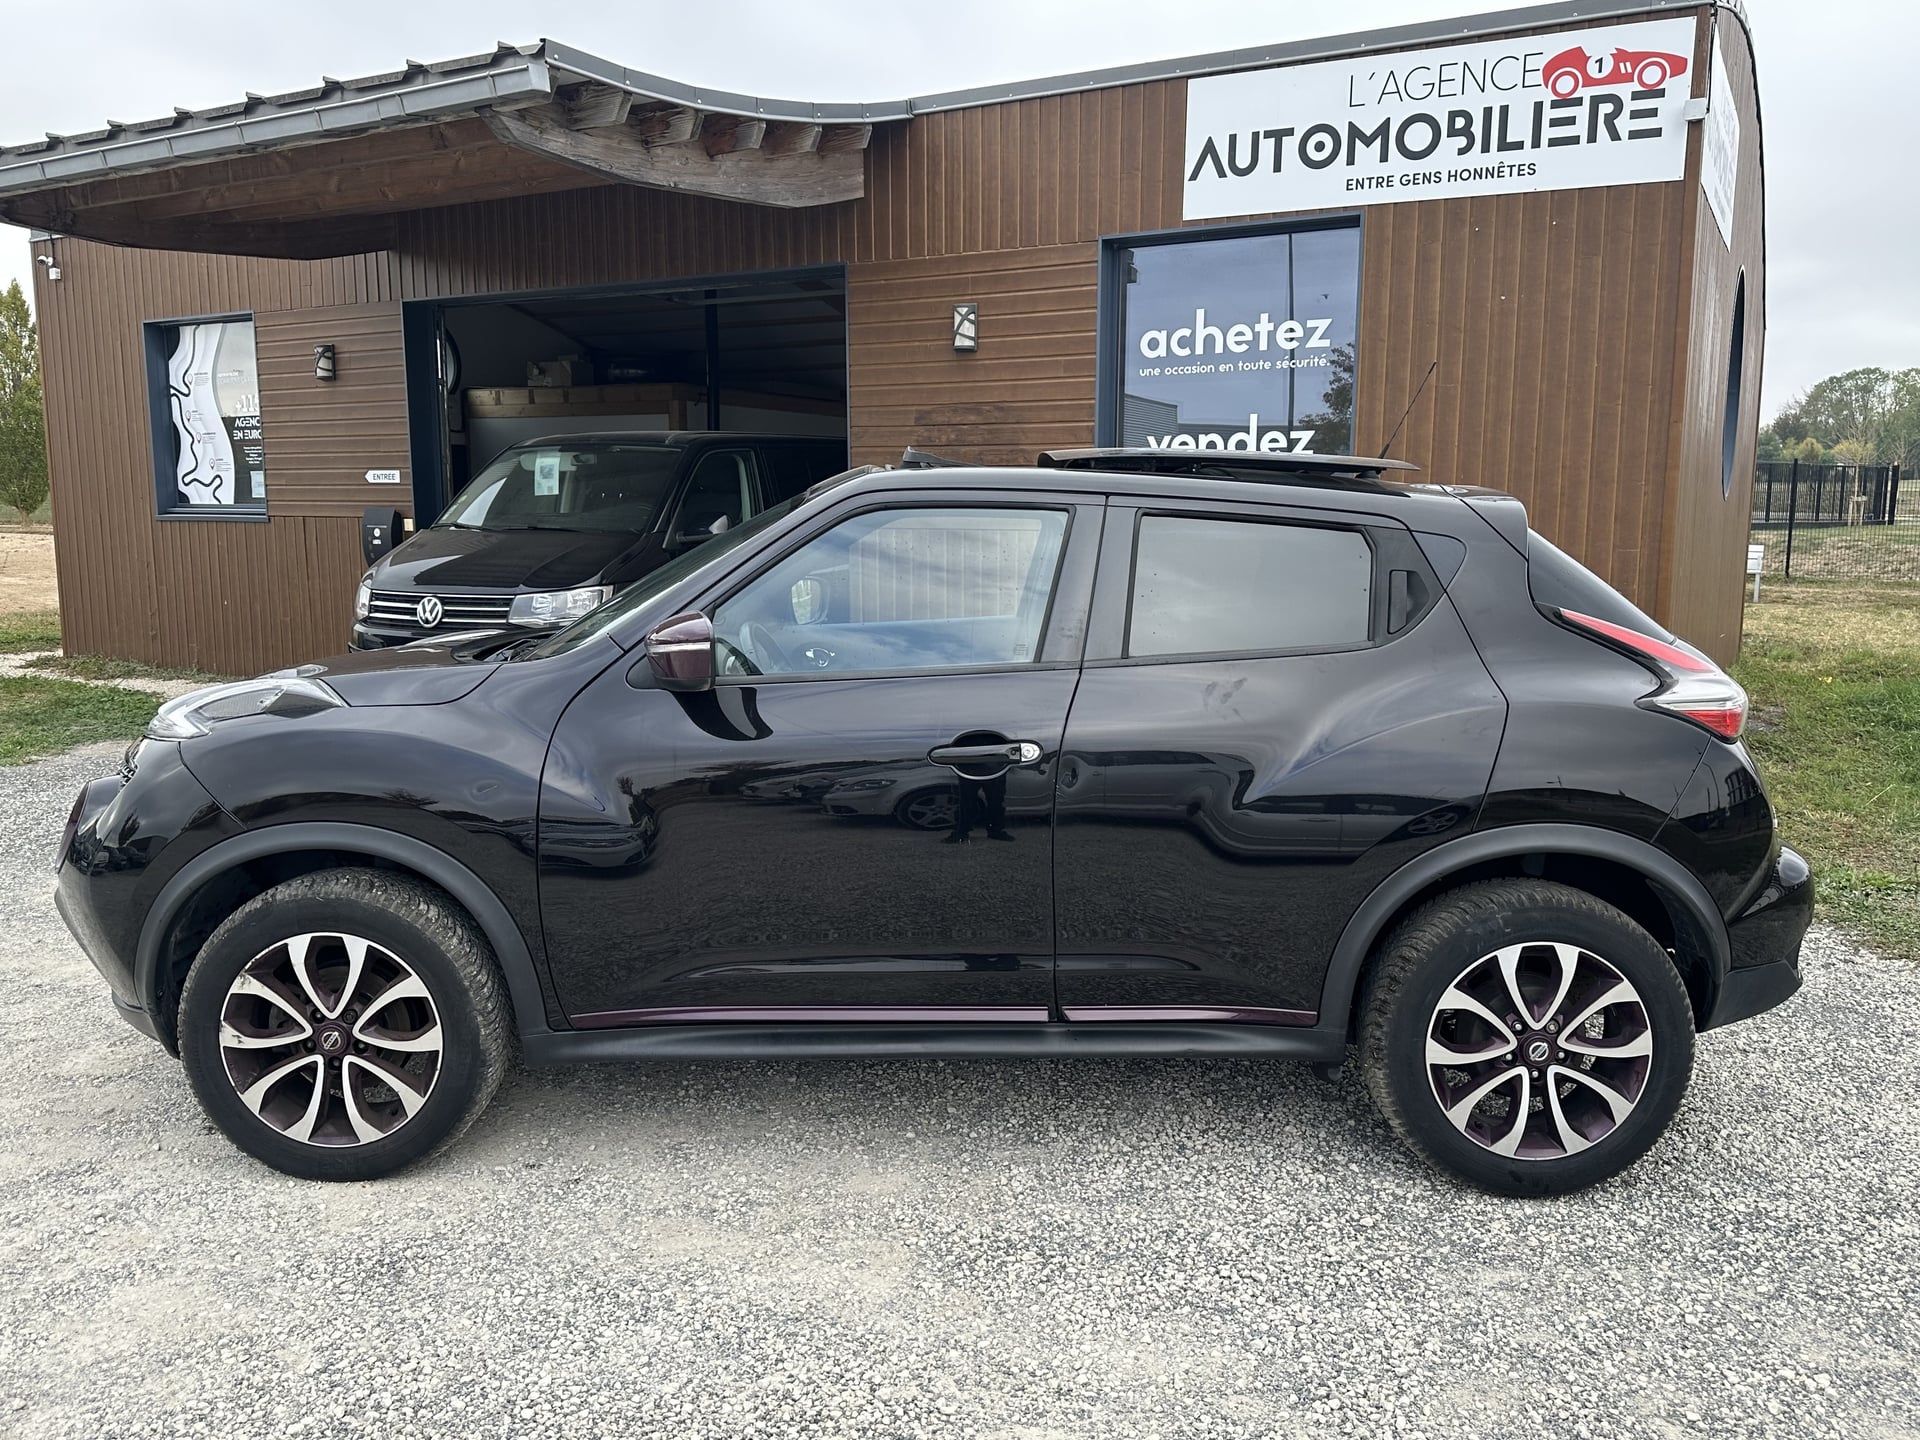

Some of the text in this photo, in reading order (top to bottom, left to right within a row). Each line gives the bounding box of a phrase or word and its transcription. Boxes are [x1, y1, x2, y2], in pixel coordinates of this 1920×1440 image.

[1348, 51, 1544, 108] L'AGENCE
[1594, 56, 1604, 74] 1
[1345, 160, 1537, 191] ENTRE GENS HONNÊTES
[1139, 308, 1333, 359] achetez
[1139, 367, 1161, 377] une
[1164, 361, 1215, 376] occasion
[1218, 363, 1234, 373] en
[1238, 360, 1272, 371] toute
[233, 430, 243, 440] EN
[1146, 413, 1316, 455] vendez
